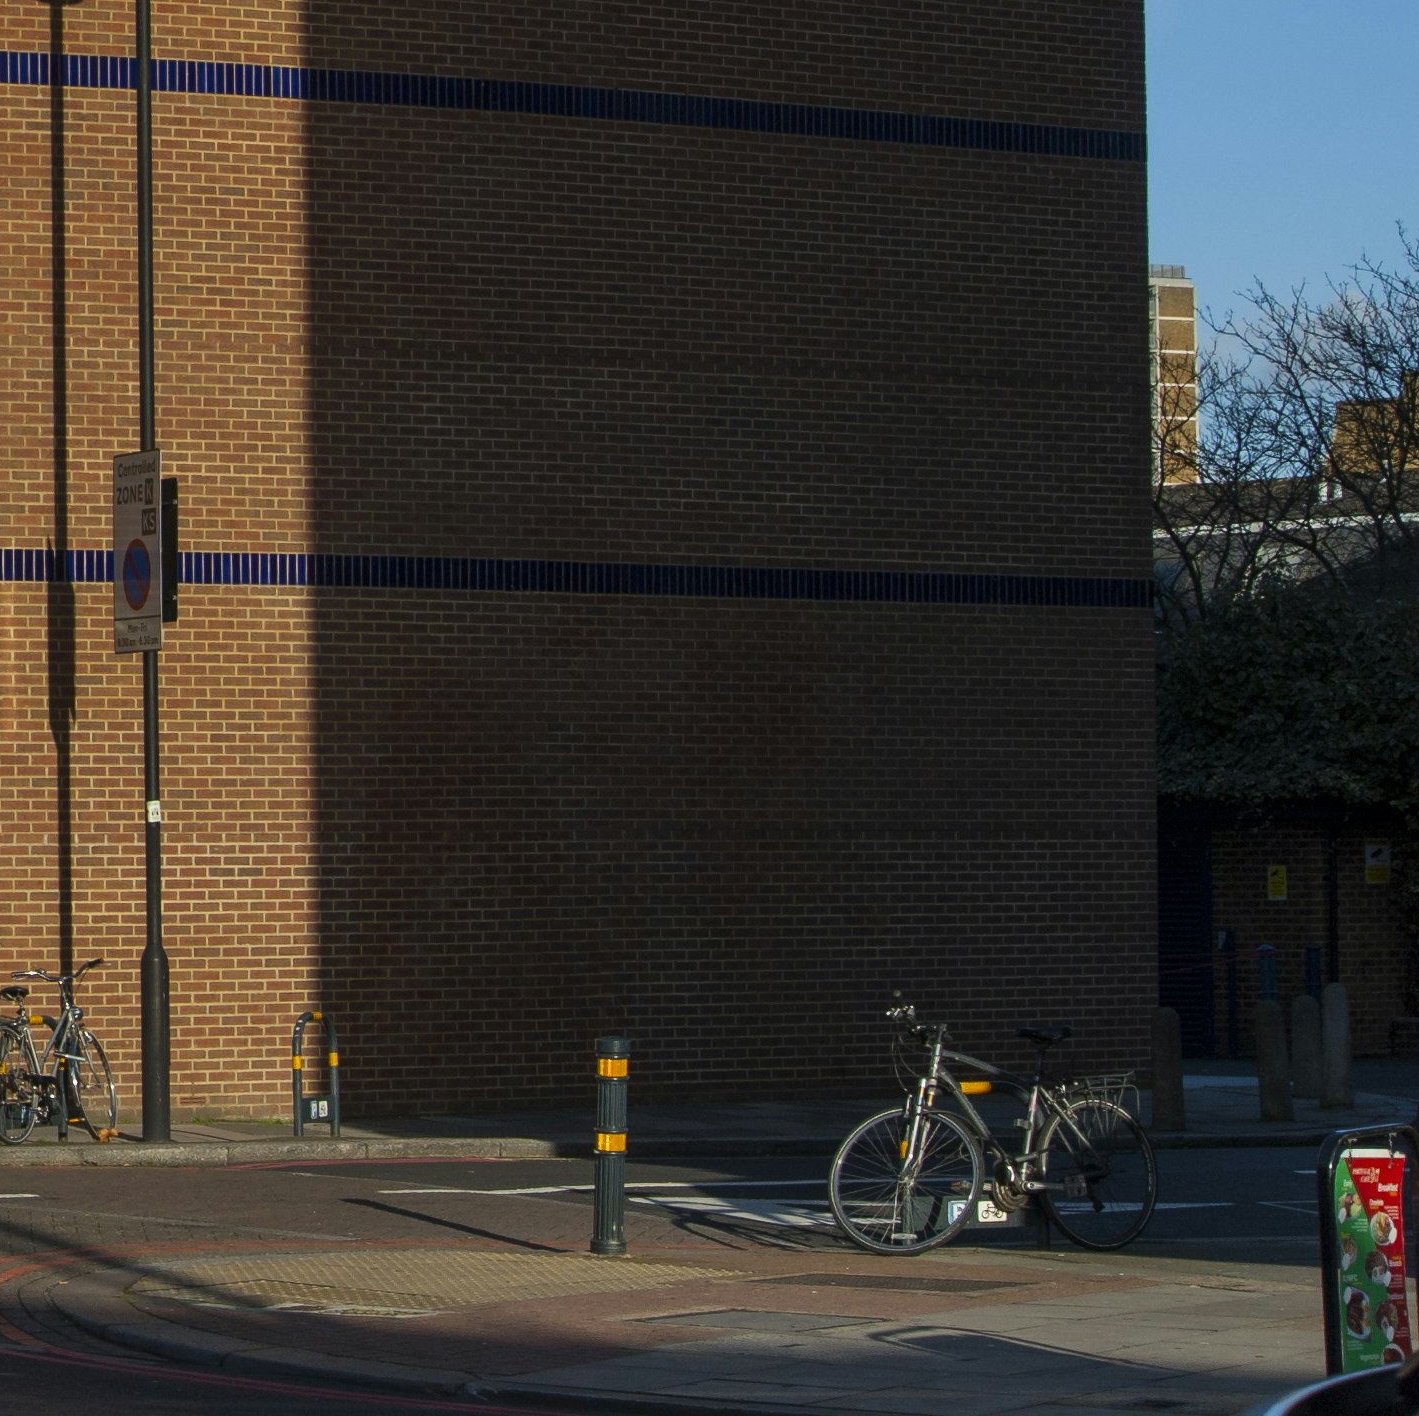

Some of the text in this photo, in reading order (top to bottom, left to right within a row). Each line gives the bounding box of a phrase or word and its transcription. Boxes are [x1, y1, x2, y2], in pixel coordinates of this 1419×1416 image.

[117, 458, 156, 478] Controlled
[116, 484, 143, 505] ZONE
[142, 511, 156, 532] KS
